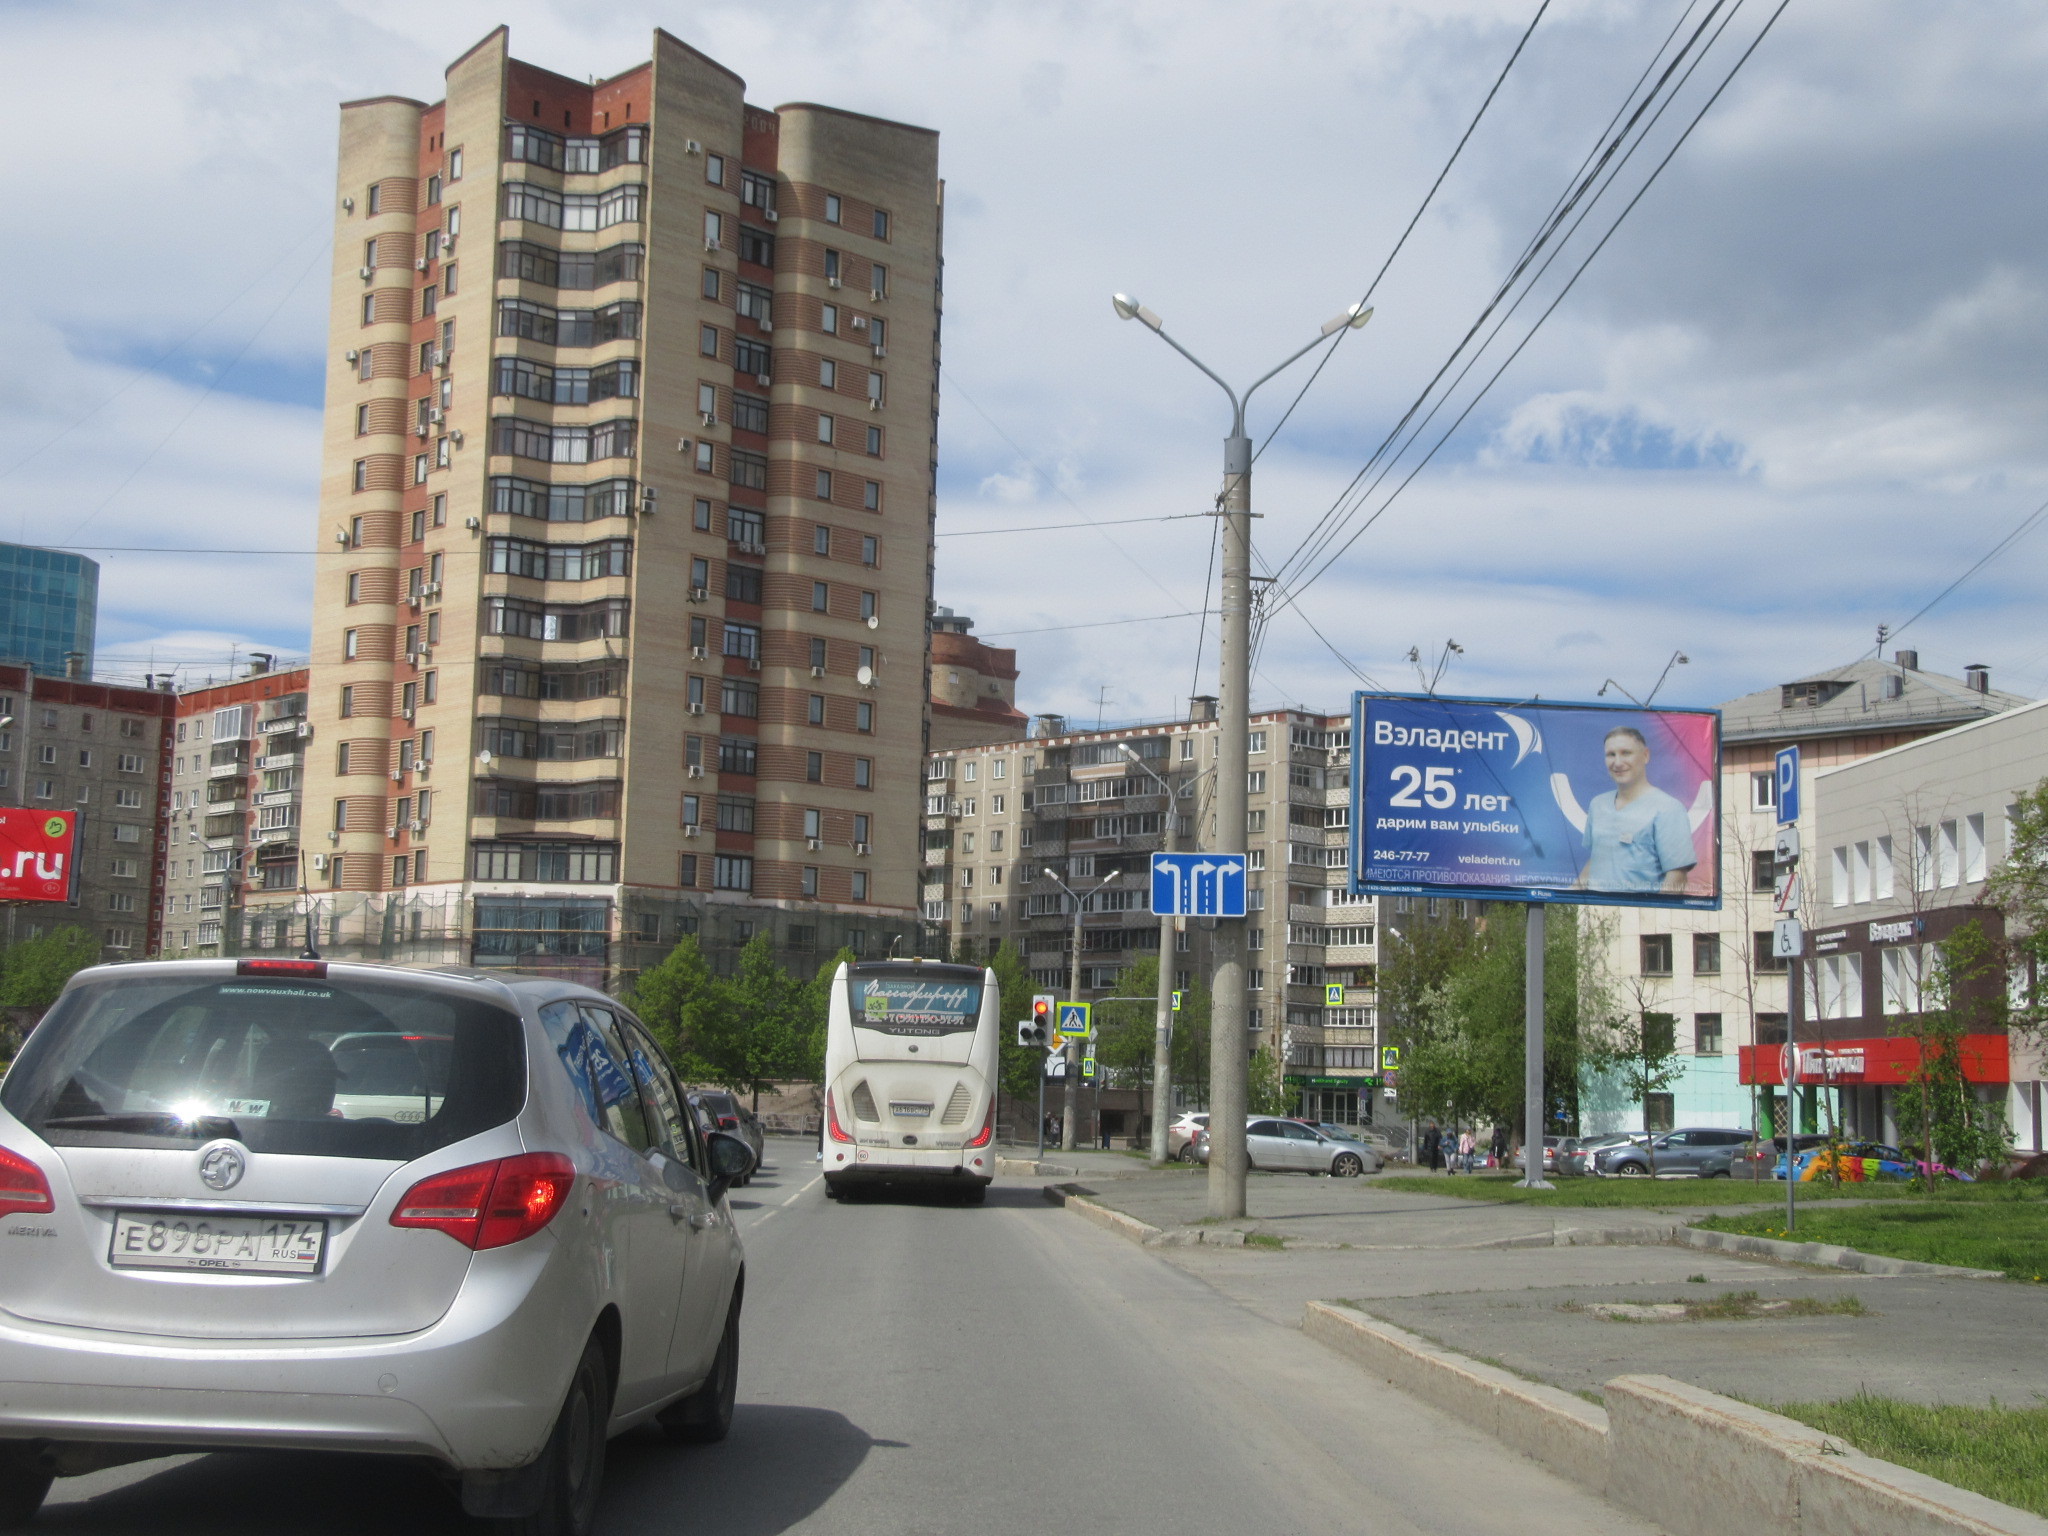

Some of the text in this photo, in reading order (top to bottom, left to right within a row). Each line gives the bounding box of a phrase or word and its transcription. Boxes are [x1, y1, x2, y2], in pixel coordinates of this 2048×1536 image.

[1374, 720, 1509, 753] Вэладент
[1779, 754, 1793, 819] P
[1463, 793, 1511, 812] лет
[1376, 817, 1519, 834] дарим вам улыбки
[1373, 850, 1430, 862] 246-77-77
[1458, 855, 1521, 866] veladent.ru
[1412, 870, 1511, 884] ПРОТИВОПОКАЗАНИЯ
[221, 987, 332, 998] www.nowvauxhall.co.uk
[889, 1027, 940, 1035] YUTONG
[8, 1226, 57, 1237] MERIVA
[266, 1223, 313, 1249] 174
[272, 1249, 297, 1258] RUS
[198, 1259, 230, 1268] OPEL
